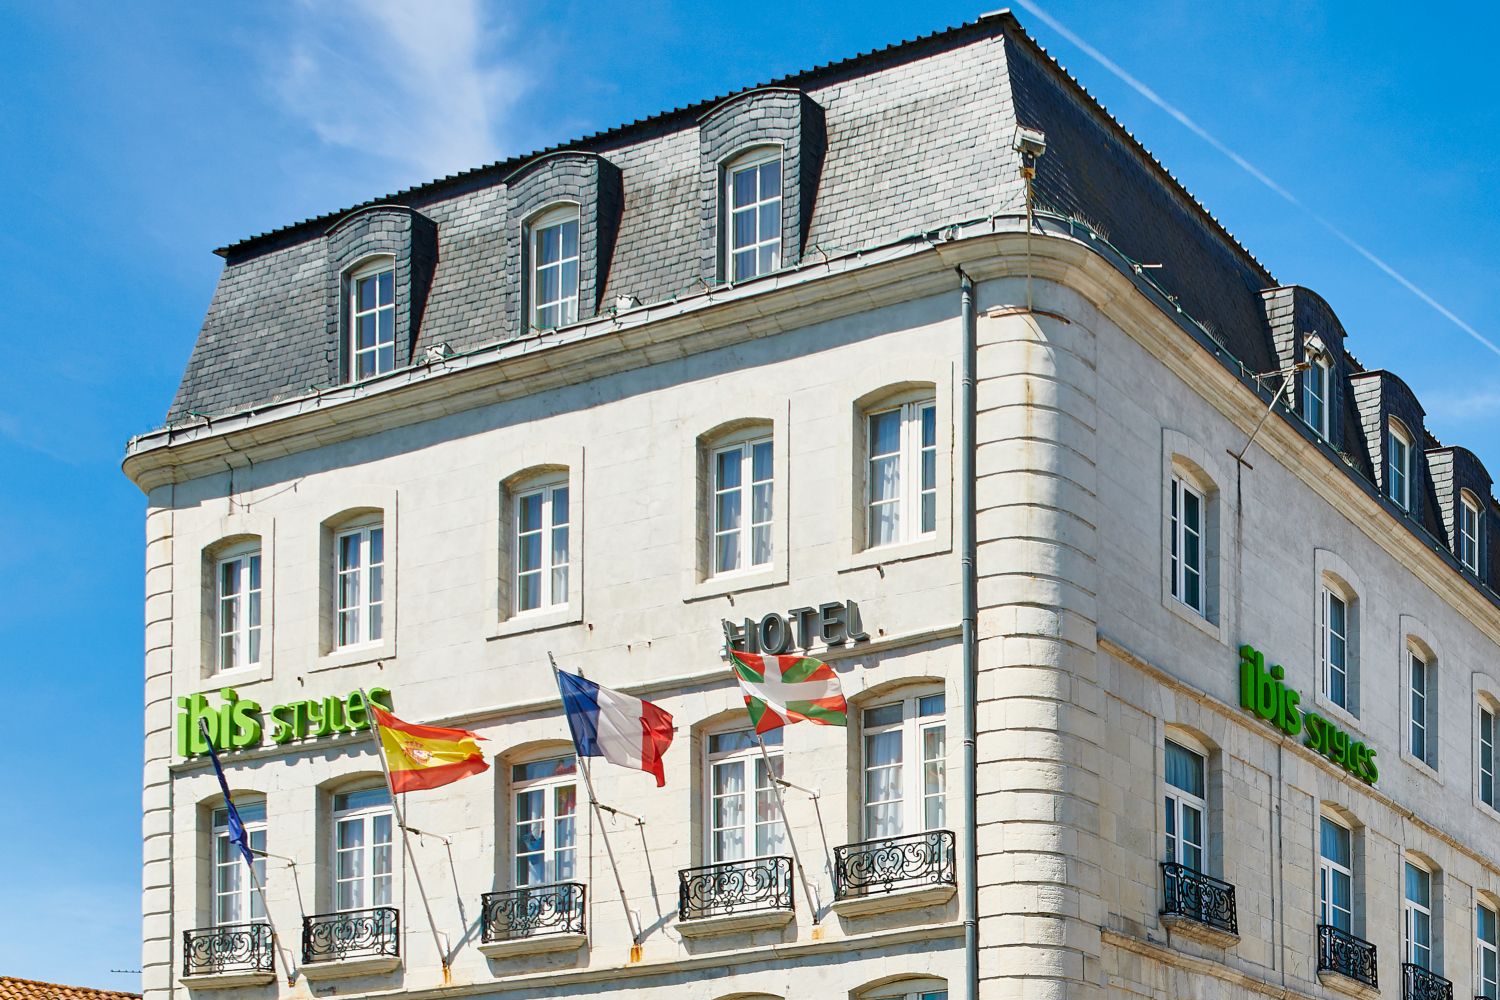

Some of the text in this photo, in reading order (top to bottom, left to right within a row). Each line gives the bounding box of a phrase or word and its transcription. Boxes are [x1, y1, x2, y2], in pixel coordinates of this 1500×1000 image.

[725, 599, 871, 658] HOTEL
[177, 687, 263, 757] ibis
[1240, 644, 1302, 736] ibis
